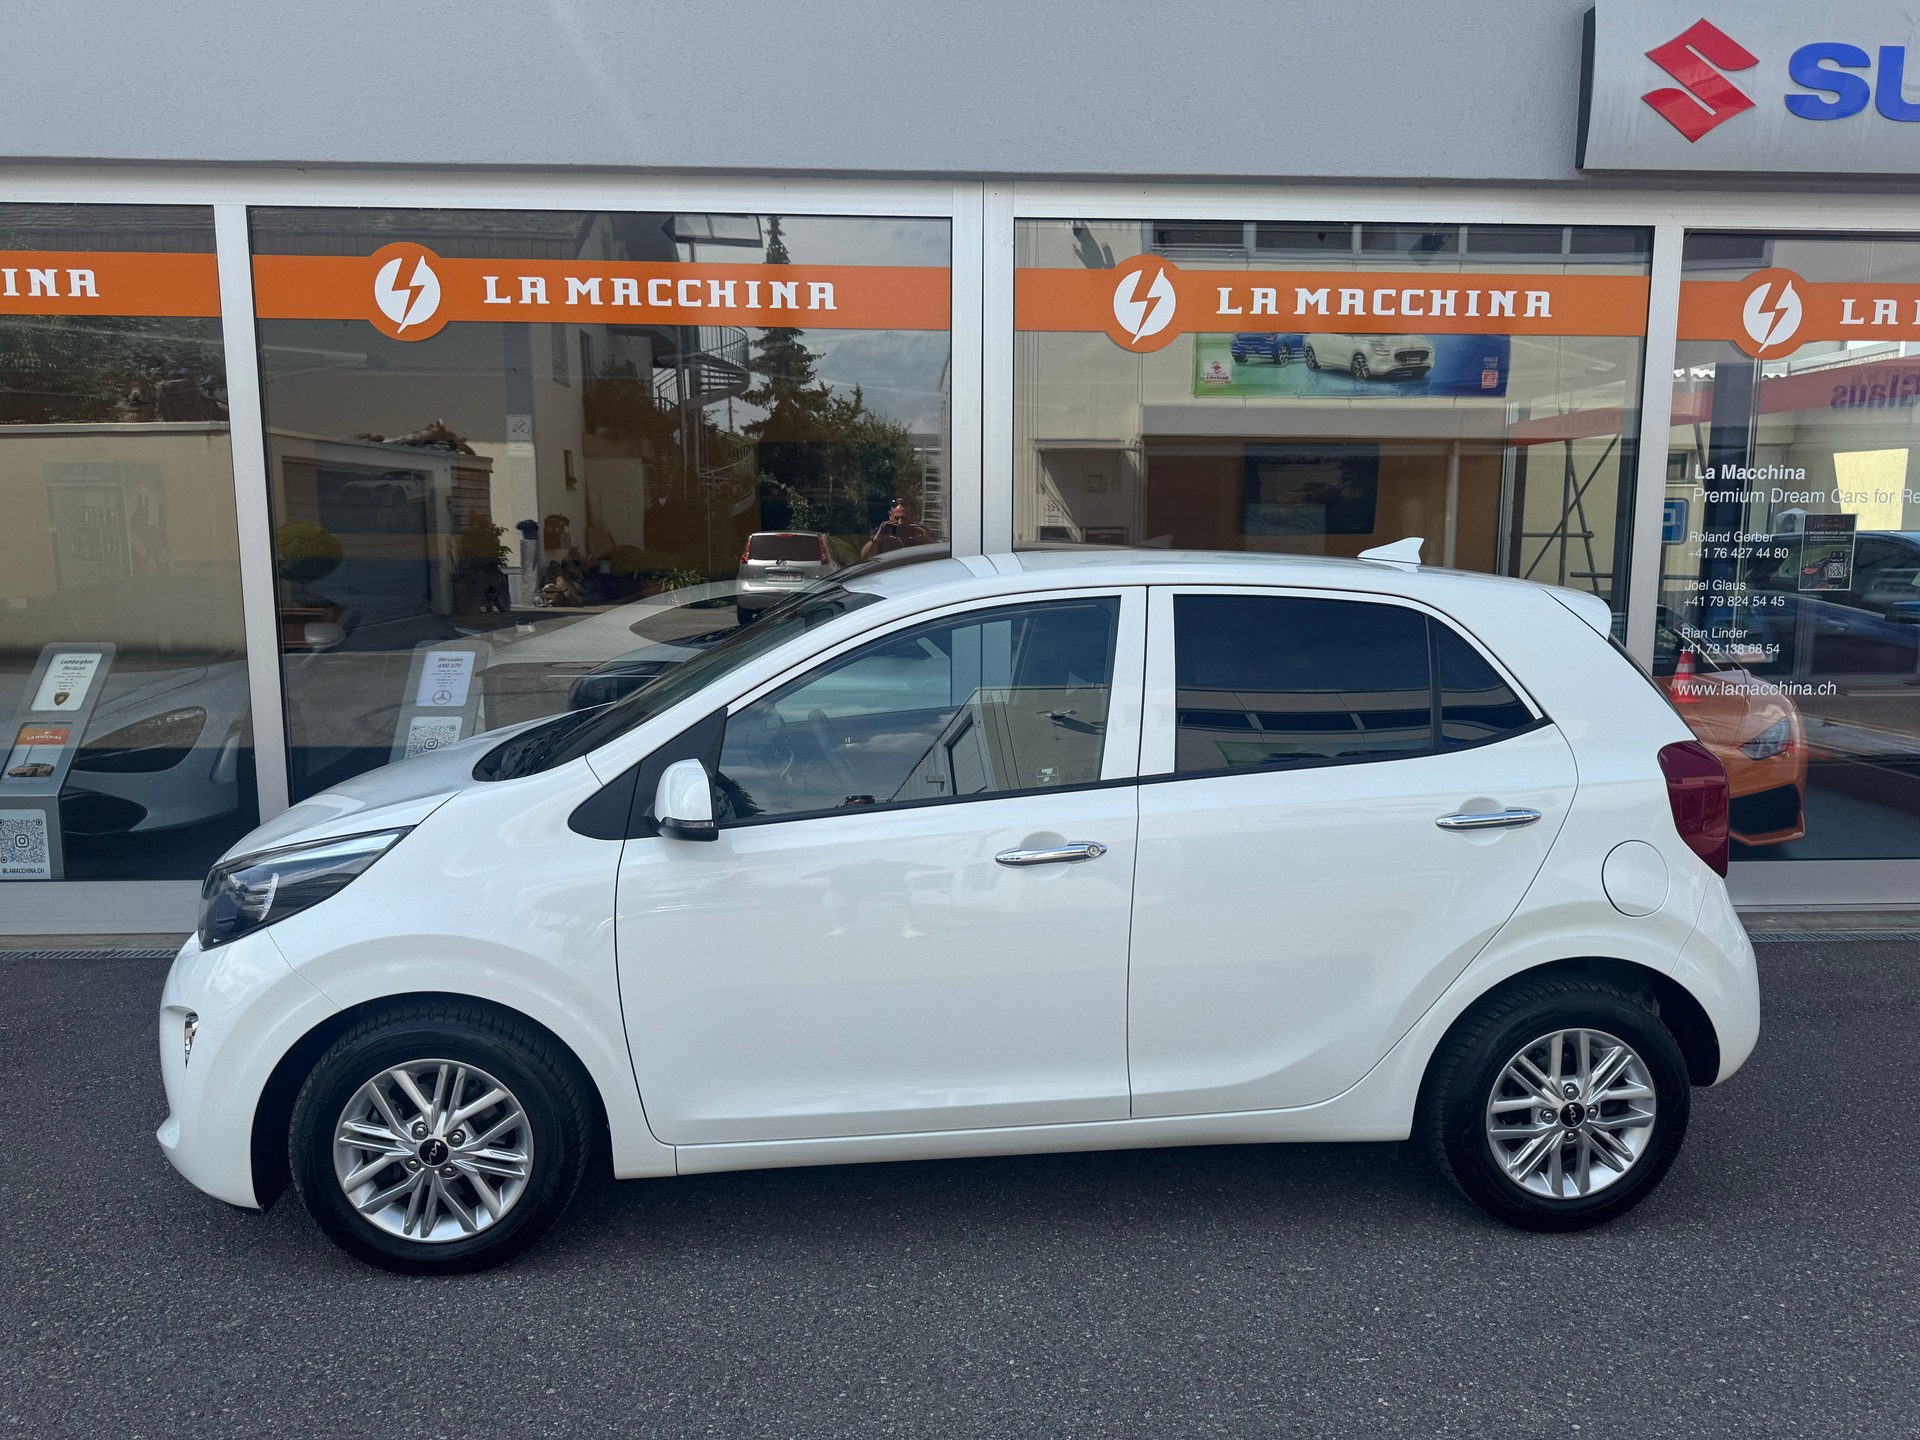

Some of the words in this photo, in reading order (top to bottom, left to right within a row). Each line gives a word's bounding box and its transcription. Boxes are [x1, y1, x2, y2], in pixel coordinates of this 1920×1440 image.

[1, 268, 99, 297] INA
[482, 276, 550, 304] LA
[564, 277, 837, 310] MACCHINA
[1216, 287, 1279, 315] LA
[1293, 288, 1552, 318] MACCHINA
[1839, 299, 1898, 325] LA
[1694, 464, 1716, 480] La
[1721, 464, 1806, 481] Macchina
[1693, 488, 1765, 503] Premium
[1771, 488, 1826, 504] Dream
[1831, 489, 1869, 504] Cars
[1874, 489, 1896, 504] for
[1689, 531, 1730, 543] Roland
[1734, 531, 1774, 543] Gerber
[1687, 548, 1708, 559] +41
[1713, 548, 1727, 558] 76
[1730, 548, 1753, 559] 427
[1756, 548, 1770, 559] 44
[1774, 548, 1789, 559] 80
[1685, 579, 1709, 591] Joel
[1712, 579, 1747, 591] Glaus
[1683, 596, 1705, 607] +41
[1710, 596, 1724, 607] 79
[1727, 596, 1749, 607] 824
[1752, 596, 1767, 607] 54
[1770, 596, 1785, 607] 45
[1681, 628, 1708, 639] Rian
[1712, 628, 1748, 639] Linder
[1680, 644, 1701, 654] +41
[1706, 644, 1720, 654] 79
[1725, 644, 1745, 654] 138
[1766, 644, 1780, 654] 54
[1677, 681, 1837, 696] www.lamacchina.ch
